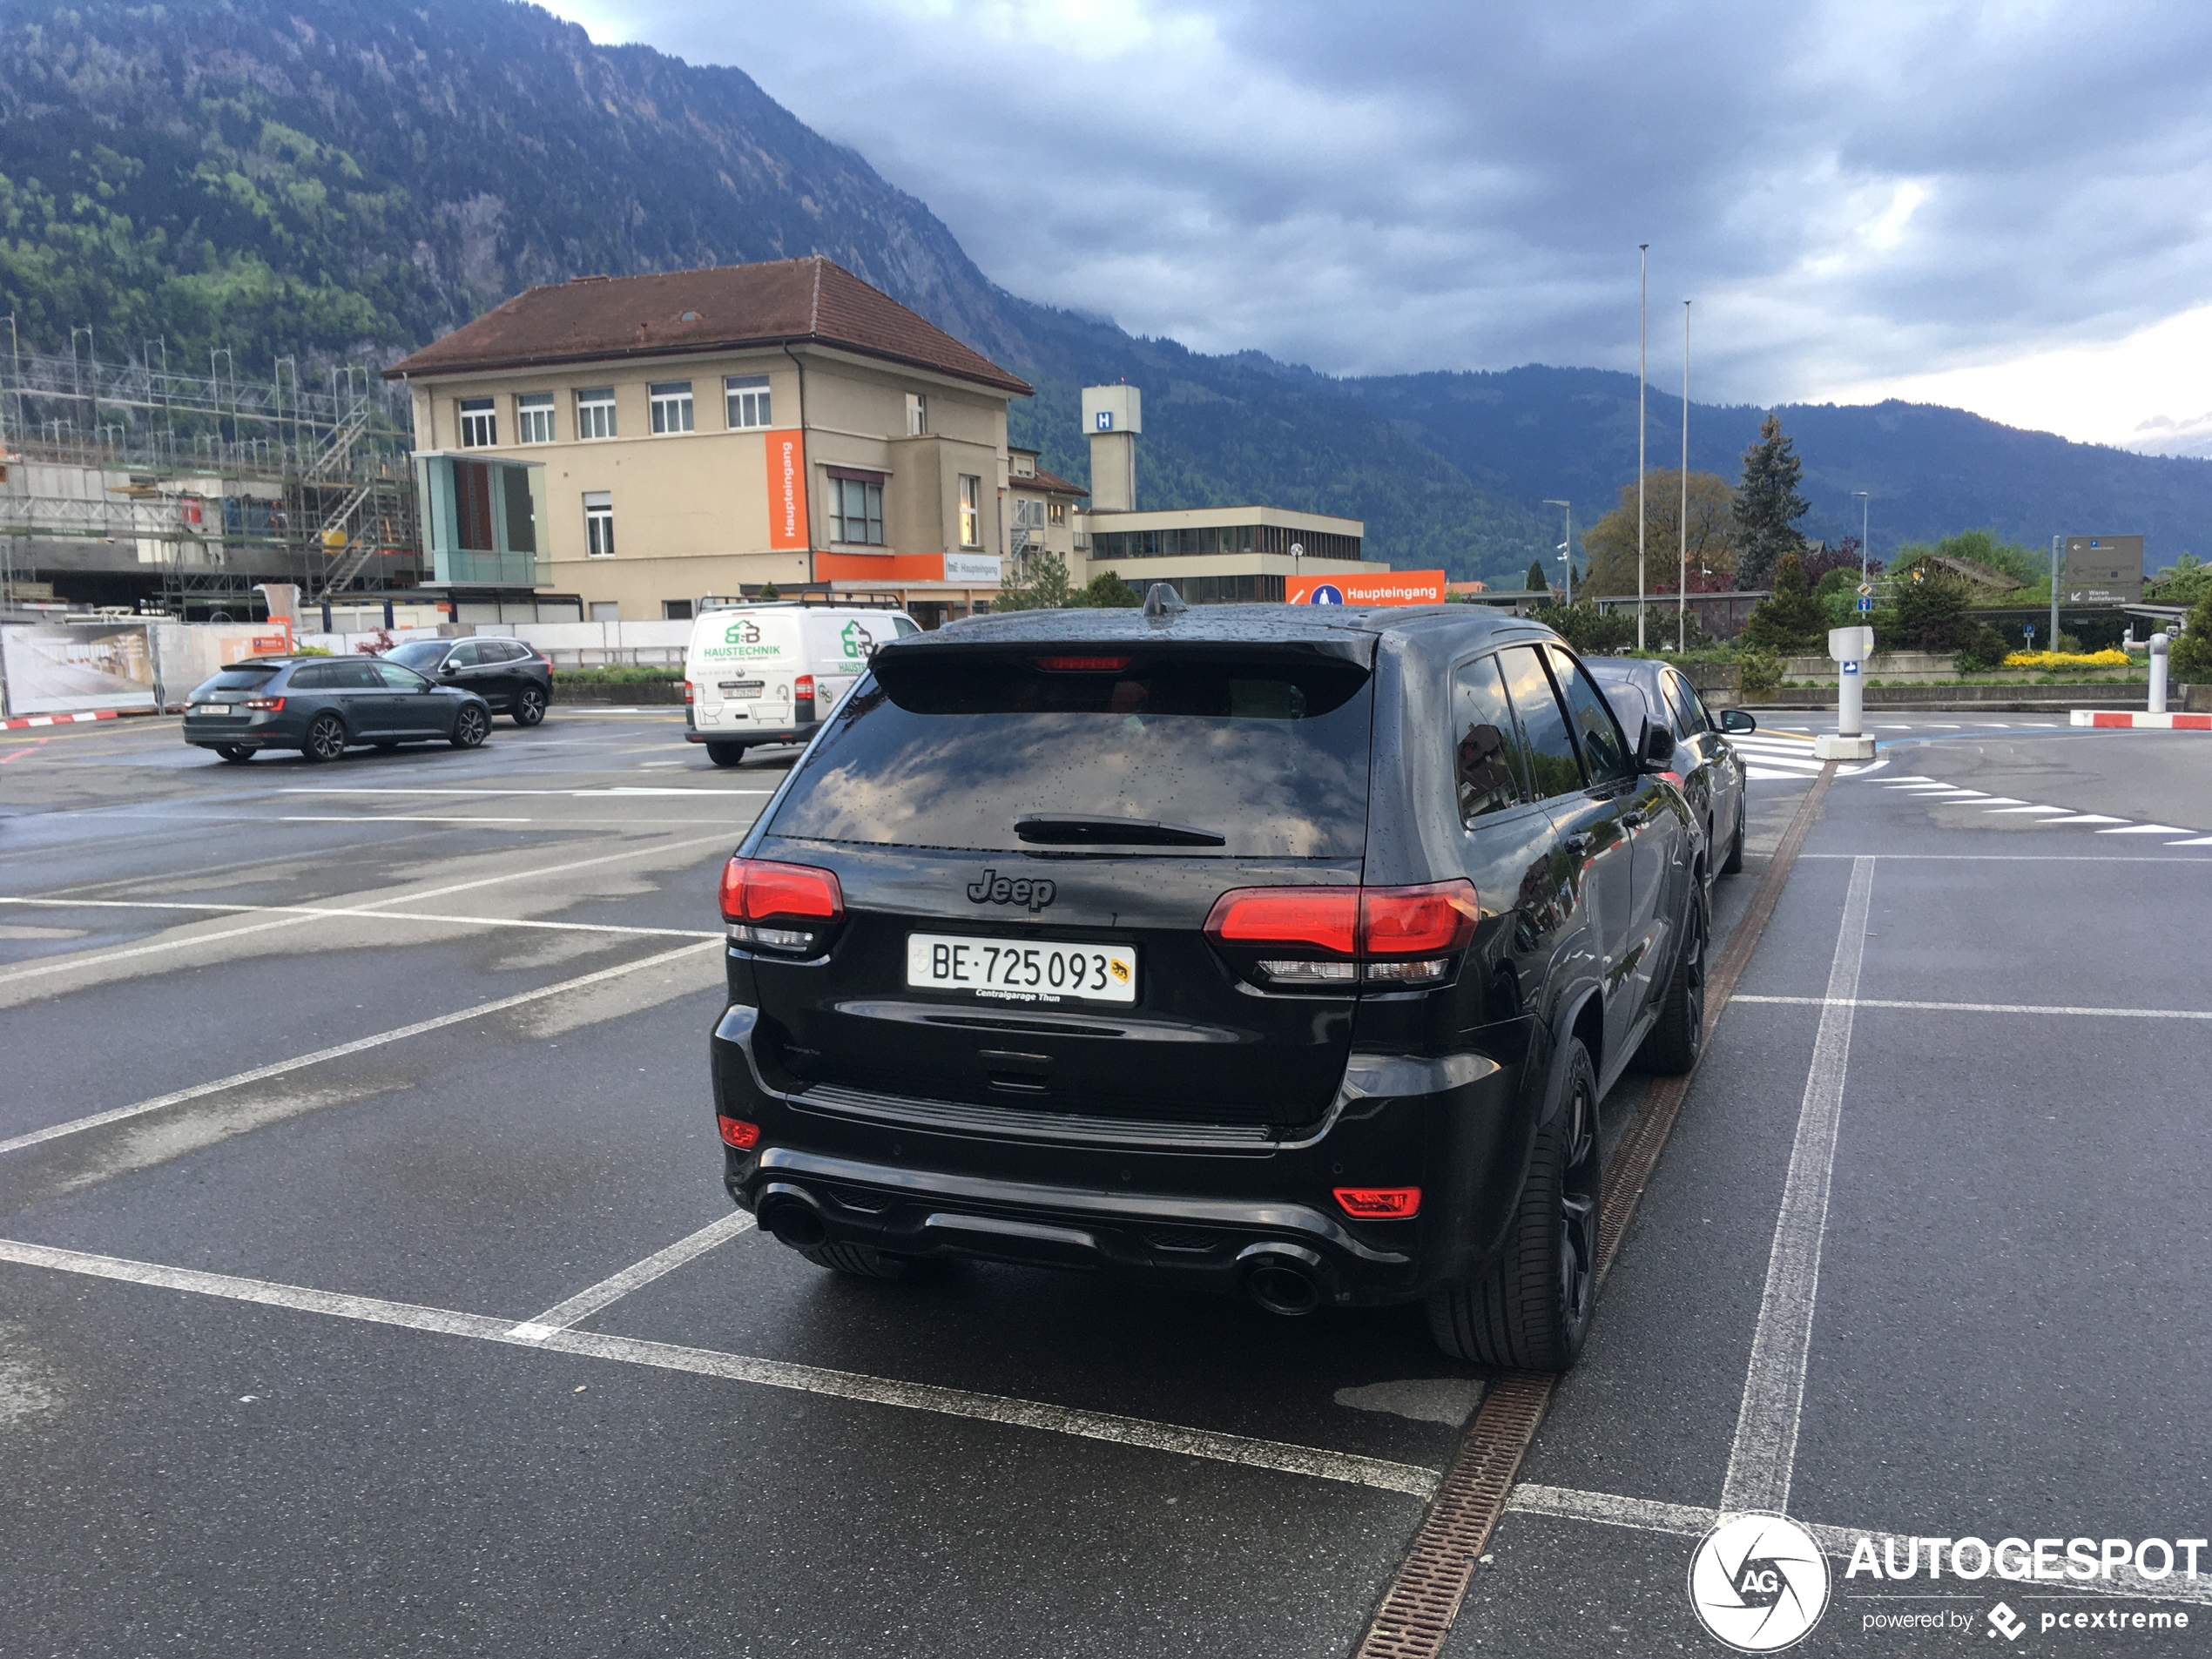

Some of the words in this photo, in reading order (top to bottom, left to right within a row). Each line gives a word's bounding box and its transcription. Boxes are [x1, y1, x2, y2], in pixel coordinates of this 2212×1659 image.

[1099, 414, 1109, 428] H
[783, 442, 796, 537] Haupteingang
[961, 563, 998, 576] Haupteingang
[1347, 586, 1437, 601] Haupteingang
[704, 645, 781, 658] HAUSTECHNIK
[968, 869, 1057, 913] Jeep
[975, 988, 1037, 1001] Centralgarage
[1038, 993, 1061, 1002] Thun
